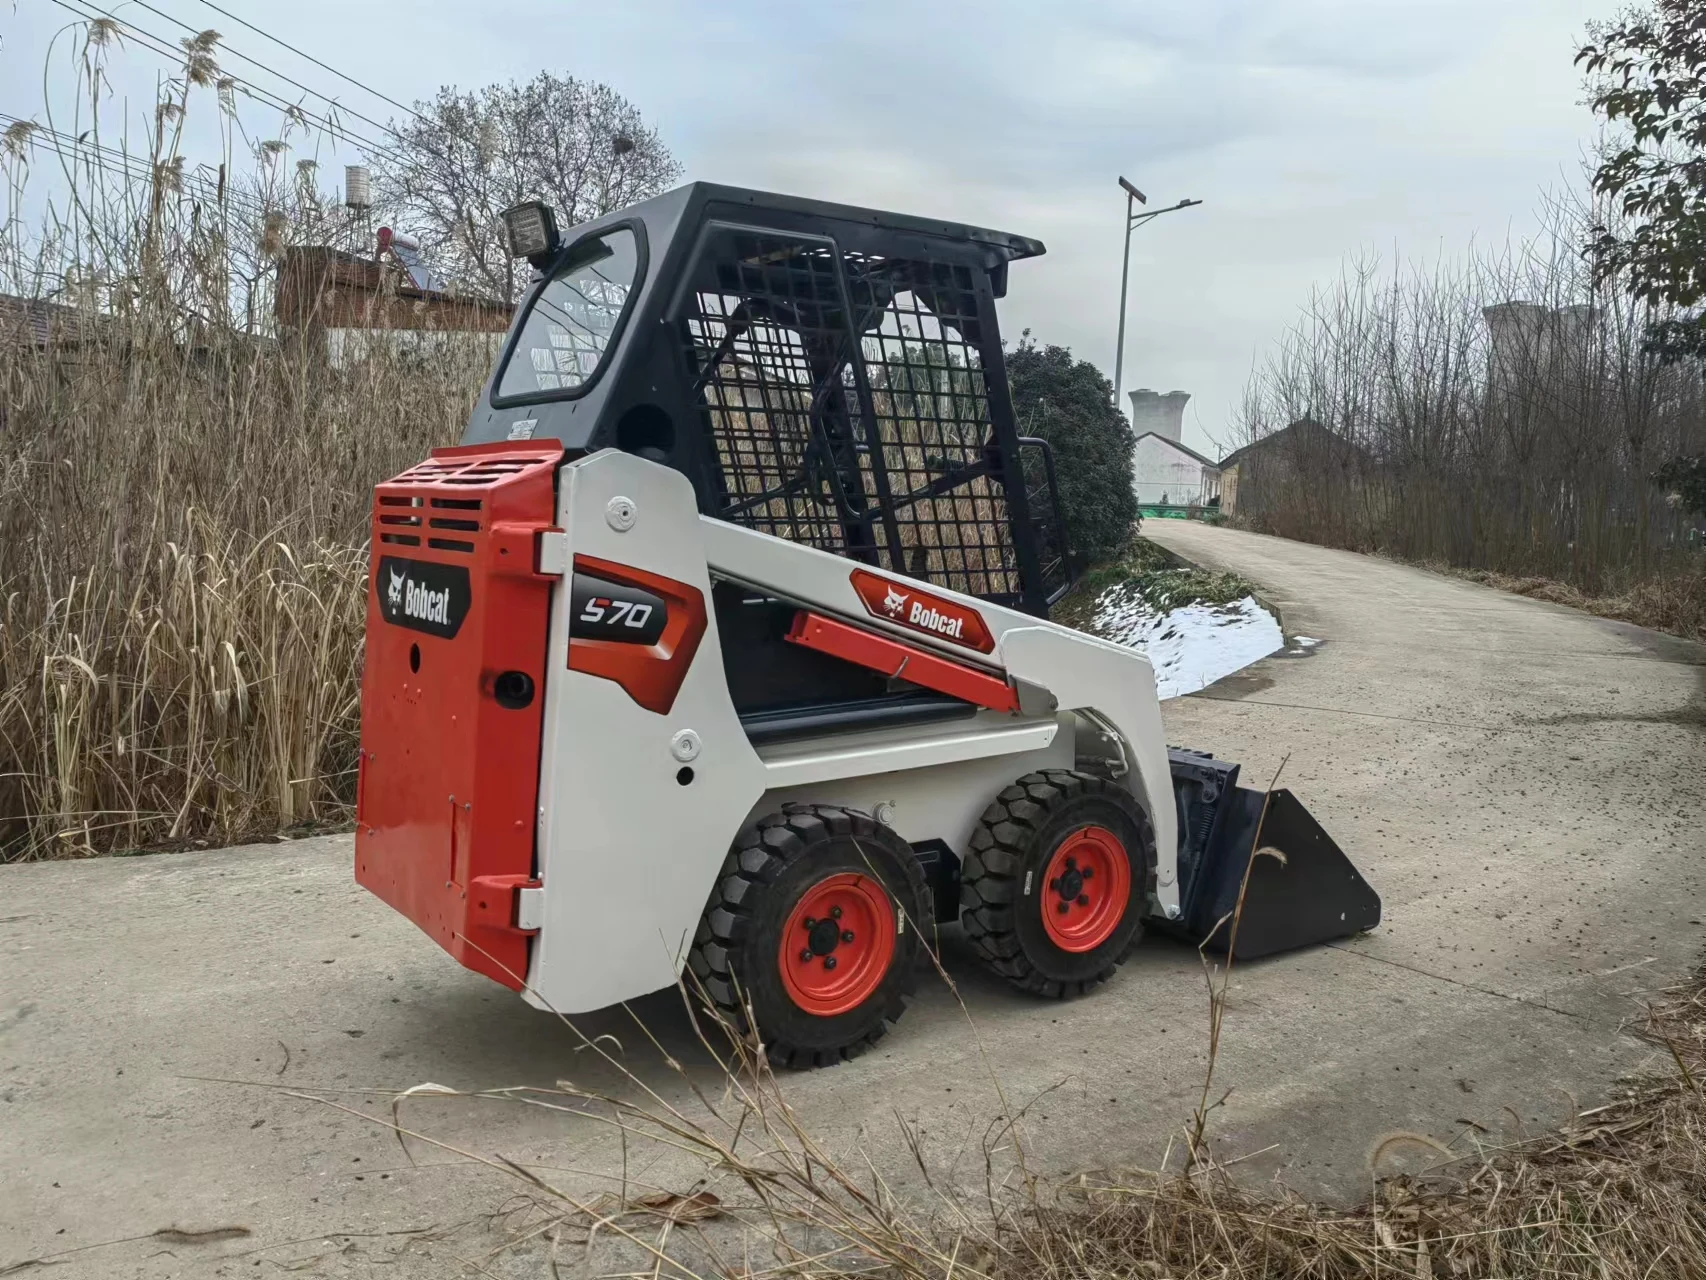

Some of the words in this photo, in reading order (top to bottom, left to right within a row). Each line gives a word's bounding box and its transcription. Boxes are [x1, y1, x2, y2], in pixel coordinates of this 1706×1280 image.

[405, 579, 449, 625] Bobcat
[580, 597, 653, 628] S70
[909, 601, 963, 638] Bobcat
